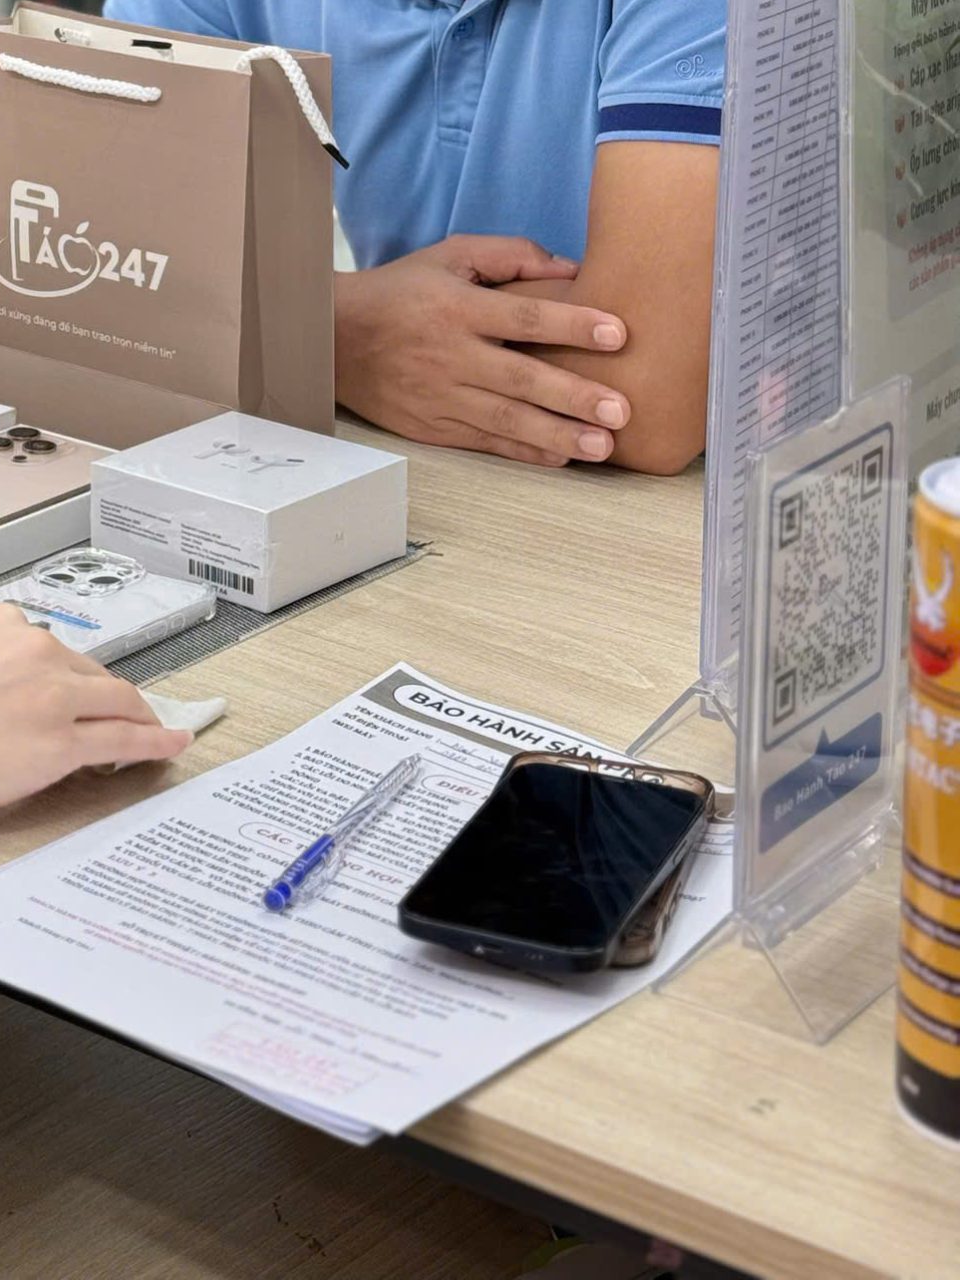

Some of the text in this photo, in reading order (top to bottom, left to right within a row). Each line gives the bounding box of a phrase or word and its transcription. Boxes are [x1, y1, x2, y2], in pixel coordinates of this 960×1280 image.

[409, 691, 465, 718] BẢO
[467, 712, 541, 747] HÀNH
[848, 745, 866, 769] 247
[257, 828, 293, 845] CÁC
